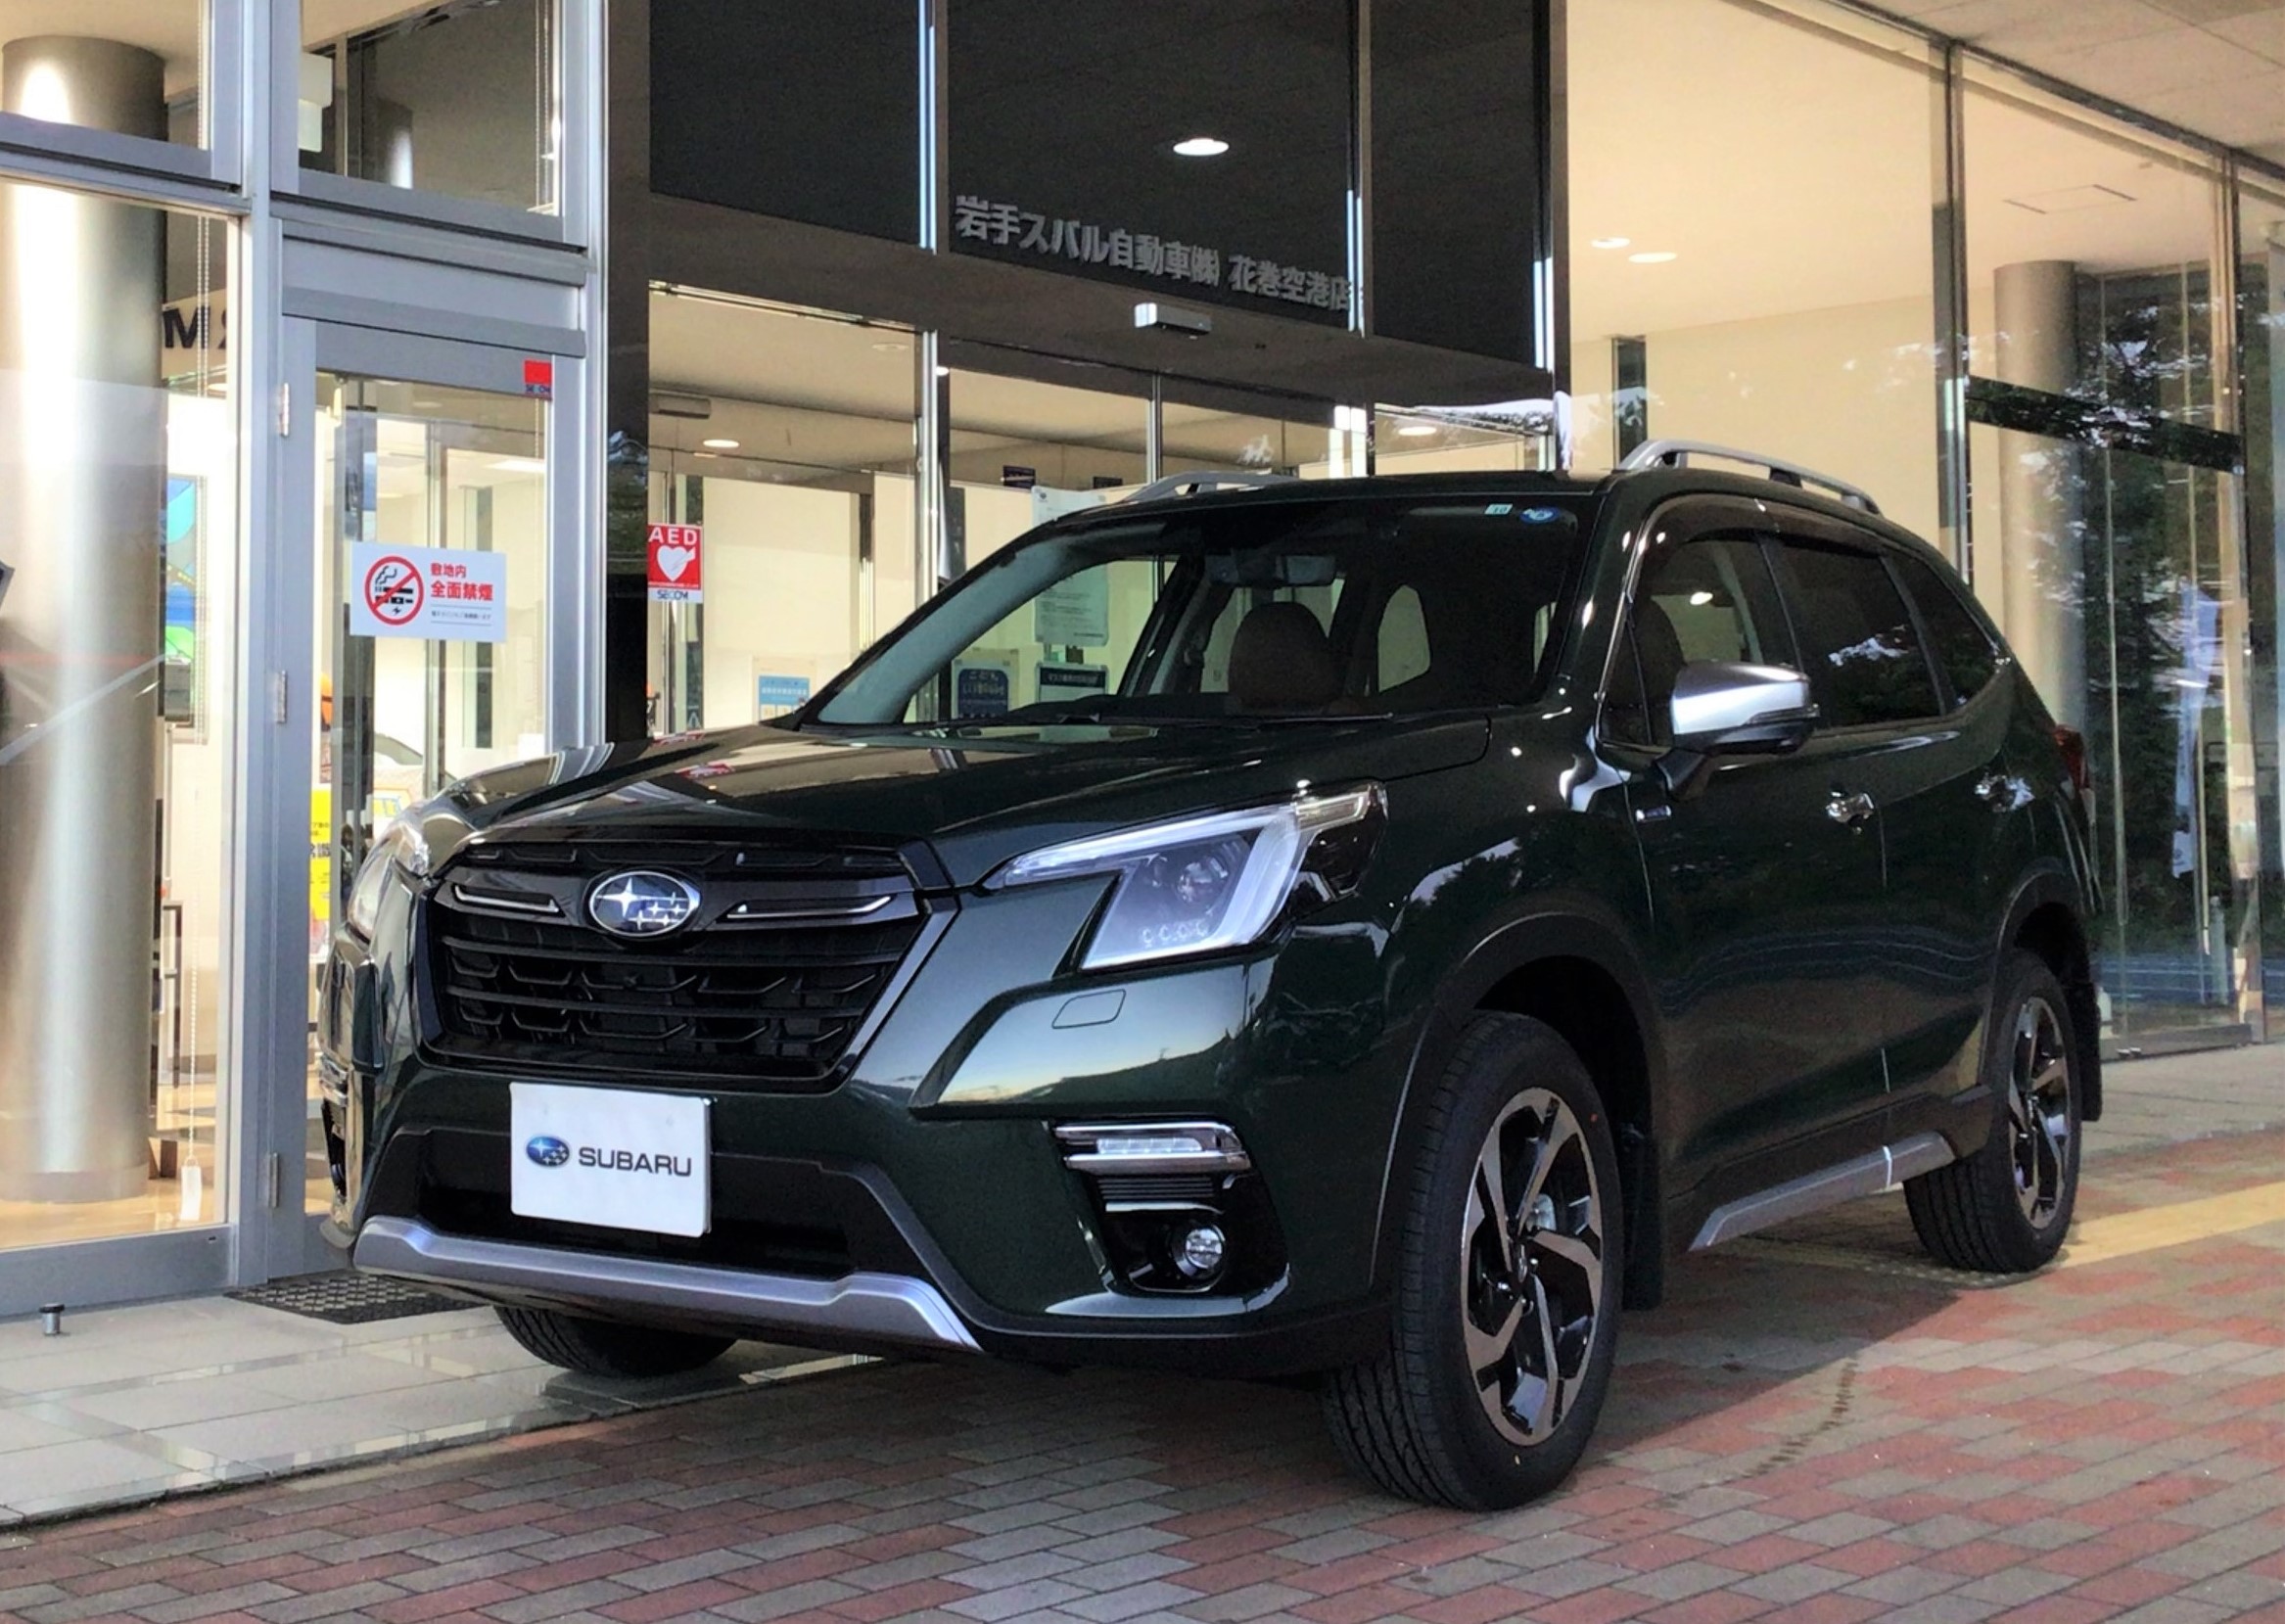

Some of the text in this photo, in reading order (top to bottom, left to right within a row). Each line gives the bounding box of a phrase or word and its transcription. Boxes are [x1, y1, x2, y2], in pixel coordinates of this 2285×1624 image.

[1228, 255, 1349, 310] 花巻空港店
[648, 527, 697, 545] AED
[431, 580, 493, 601] 全面禁煙
[579, 1146, 691, 1177] SUBARU
